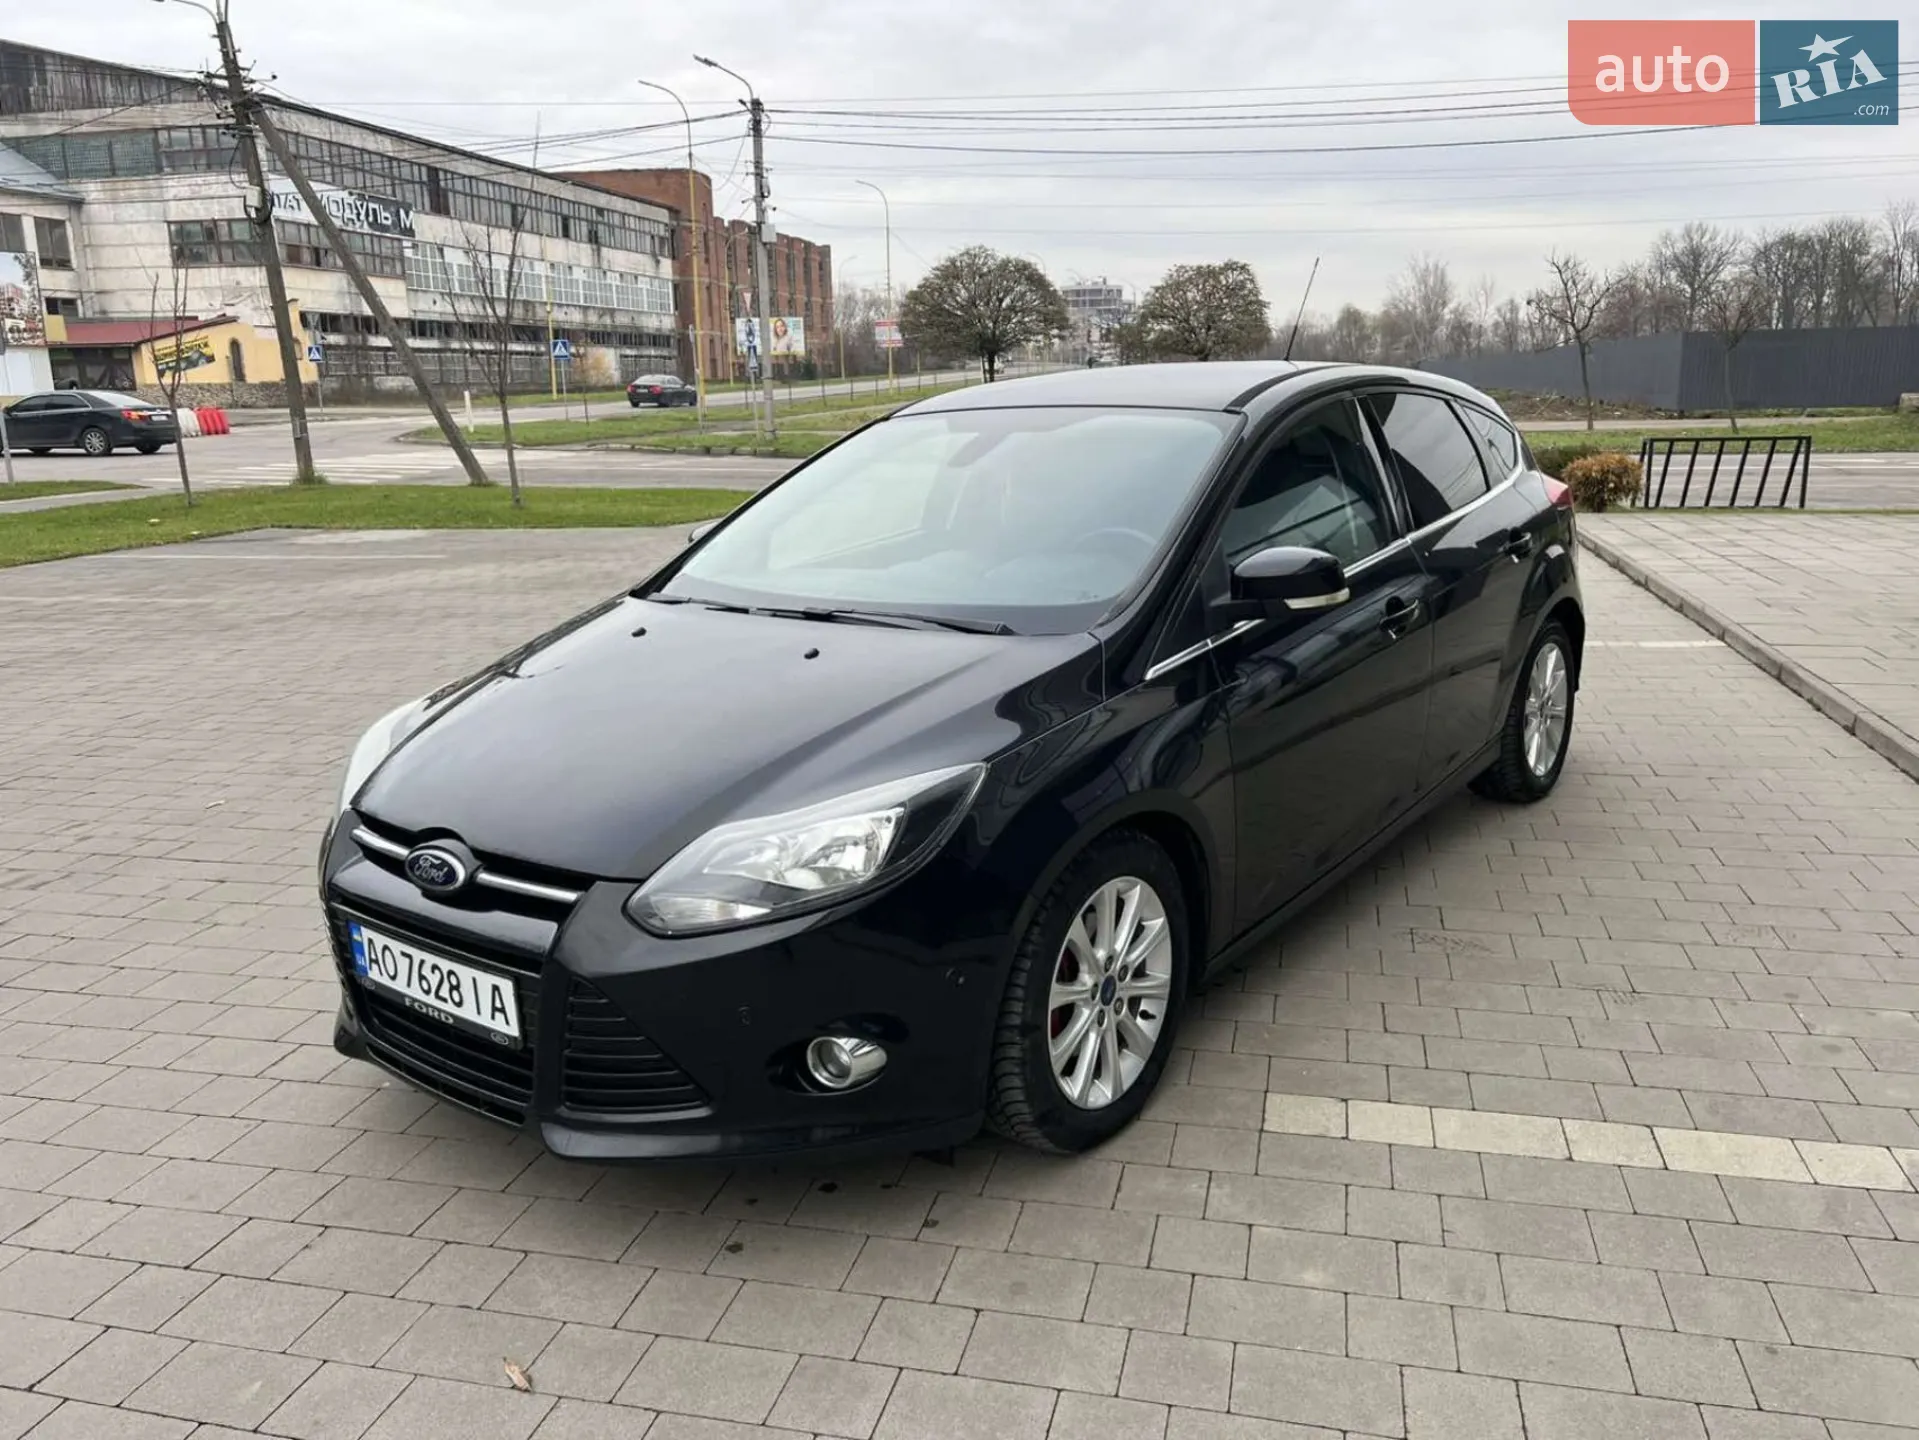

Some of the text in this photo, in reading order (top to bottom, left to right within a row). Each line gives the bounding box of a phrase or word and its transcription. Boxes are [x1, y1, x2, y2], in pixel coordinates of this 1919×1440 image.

[414, 855, 449, 883] Ford
[367, 937, 510, 1027] AO7628IA
[403, 996, 454, 1025] FORD
